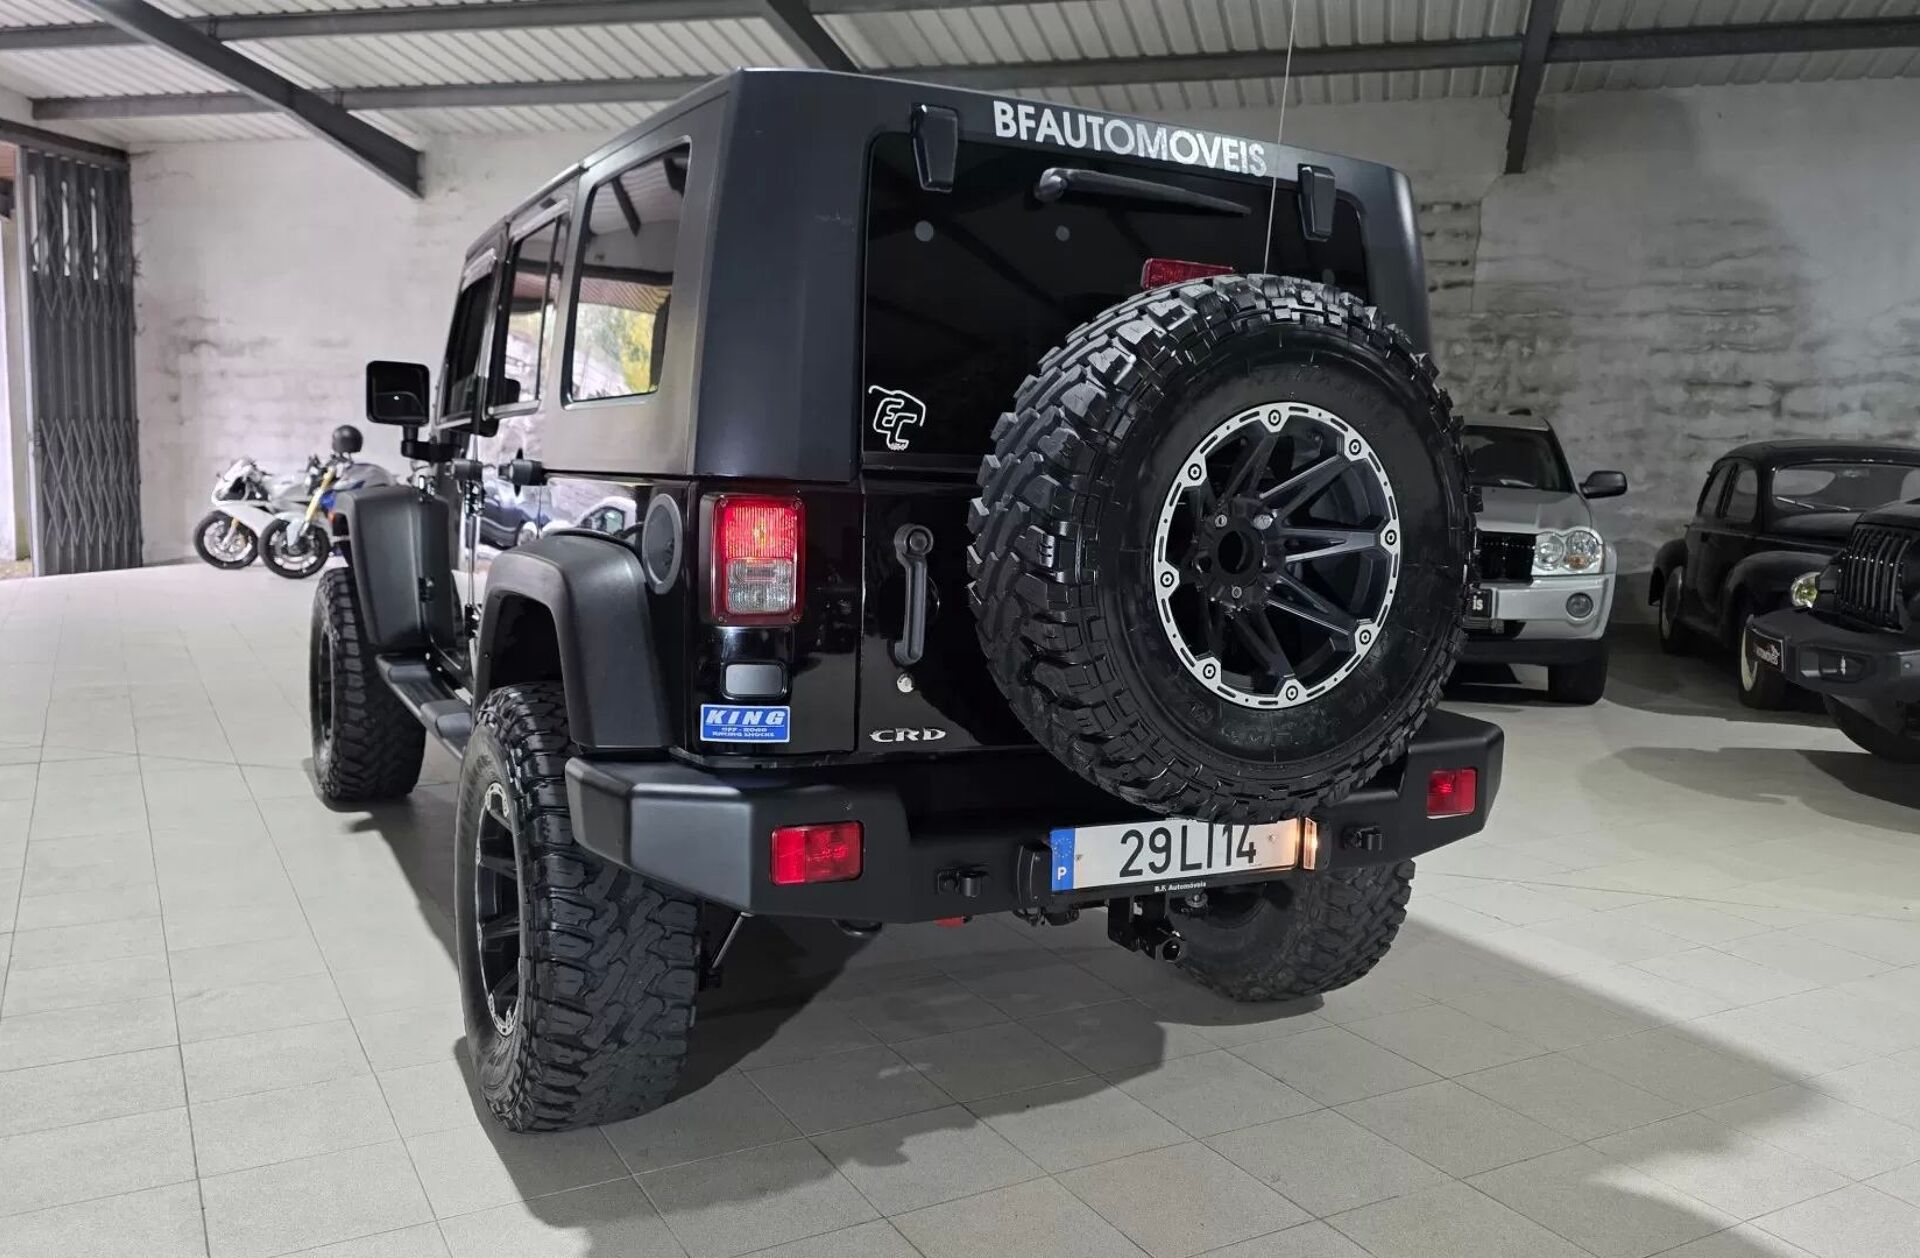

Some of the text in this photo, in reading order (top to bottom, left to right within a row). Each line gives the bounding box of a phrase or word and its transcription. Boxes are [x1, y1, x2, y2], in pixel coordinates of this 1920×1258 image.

[993, 100, 1268, 177] BFAUTOMOVEIS
[705, 709, 786, 725] KING
[869, 727, 946, 743] CRD
[1057, 867, 1067, 880] P
